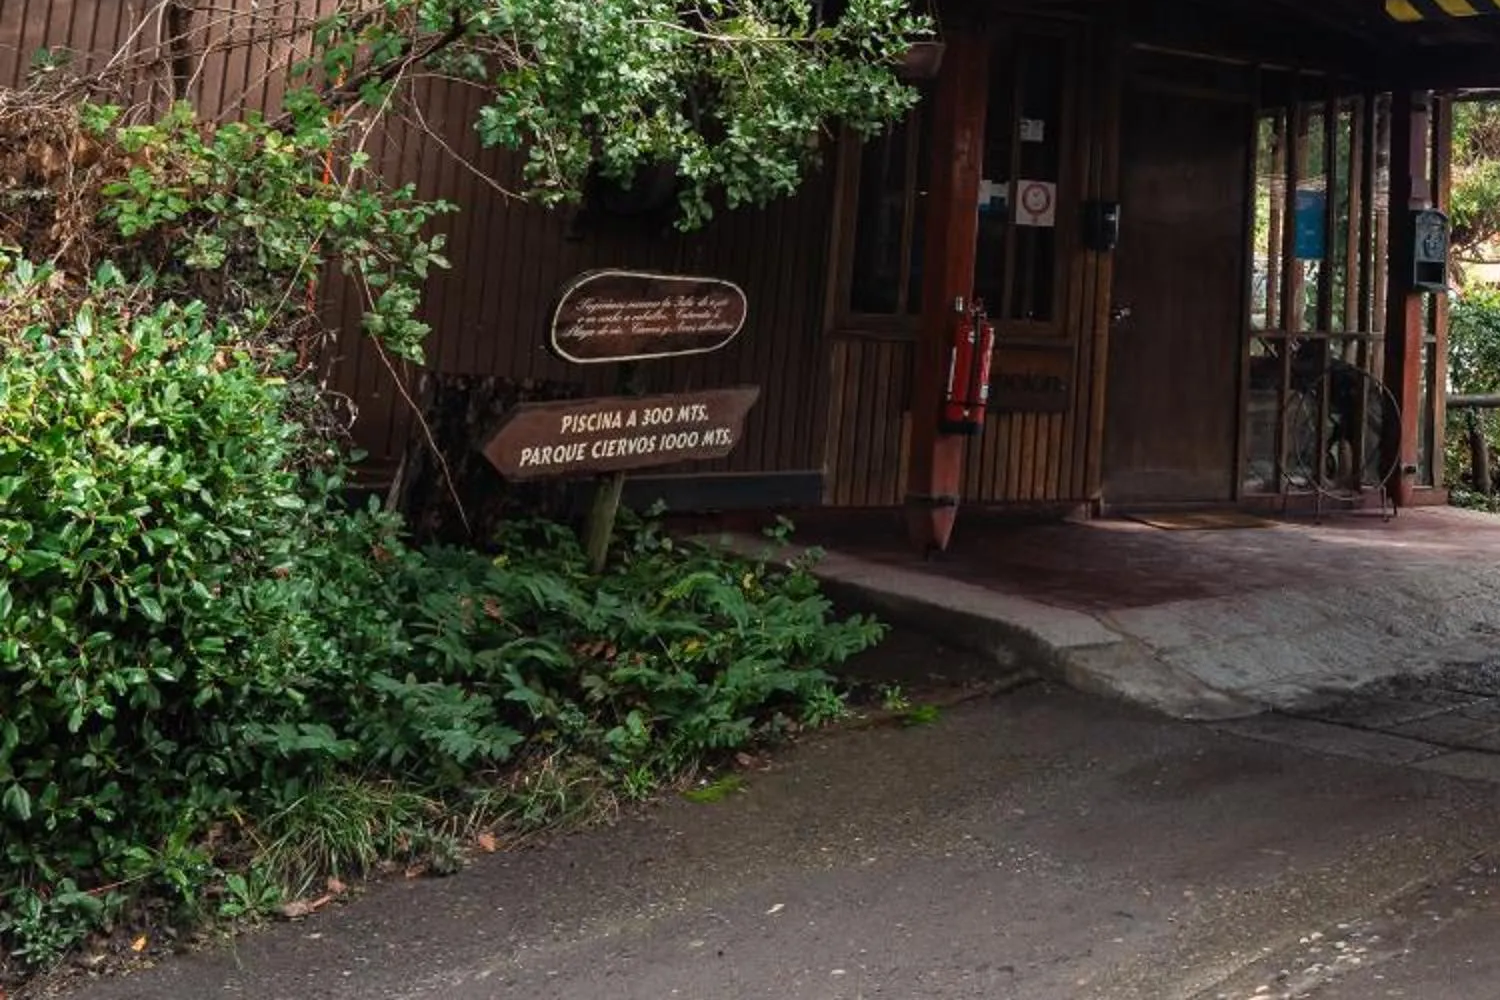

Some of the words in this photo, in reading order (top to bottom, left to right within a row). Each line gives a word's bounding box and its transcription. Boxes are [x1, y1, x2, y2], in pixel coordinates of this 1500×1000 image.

[560, 410, 621, 434] PISCINA
[626, 409, 637, 427] A
[641, 407, 673, 426] 300
[676, 404, 709, 423] MTS.
[519, 443, 587, 467] PARQUE
[591, 435, 656, 460] CIERVOS
[660, 431, 698, 451] 1000
[701, 428, 733, 448] MTS.
